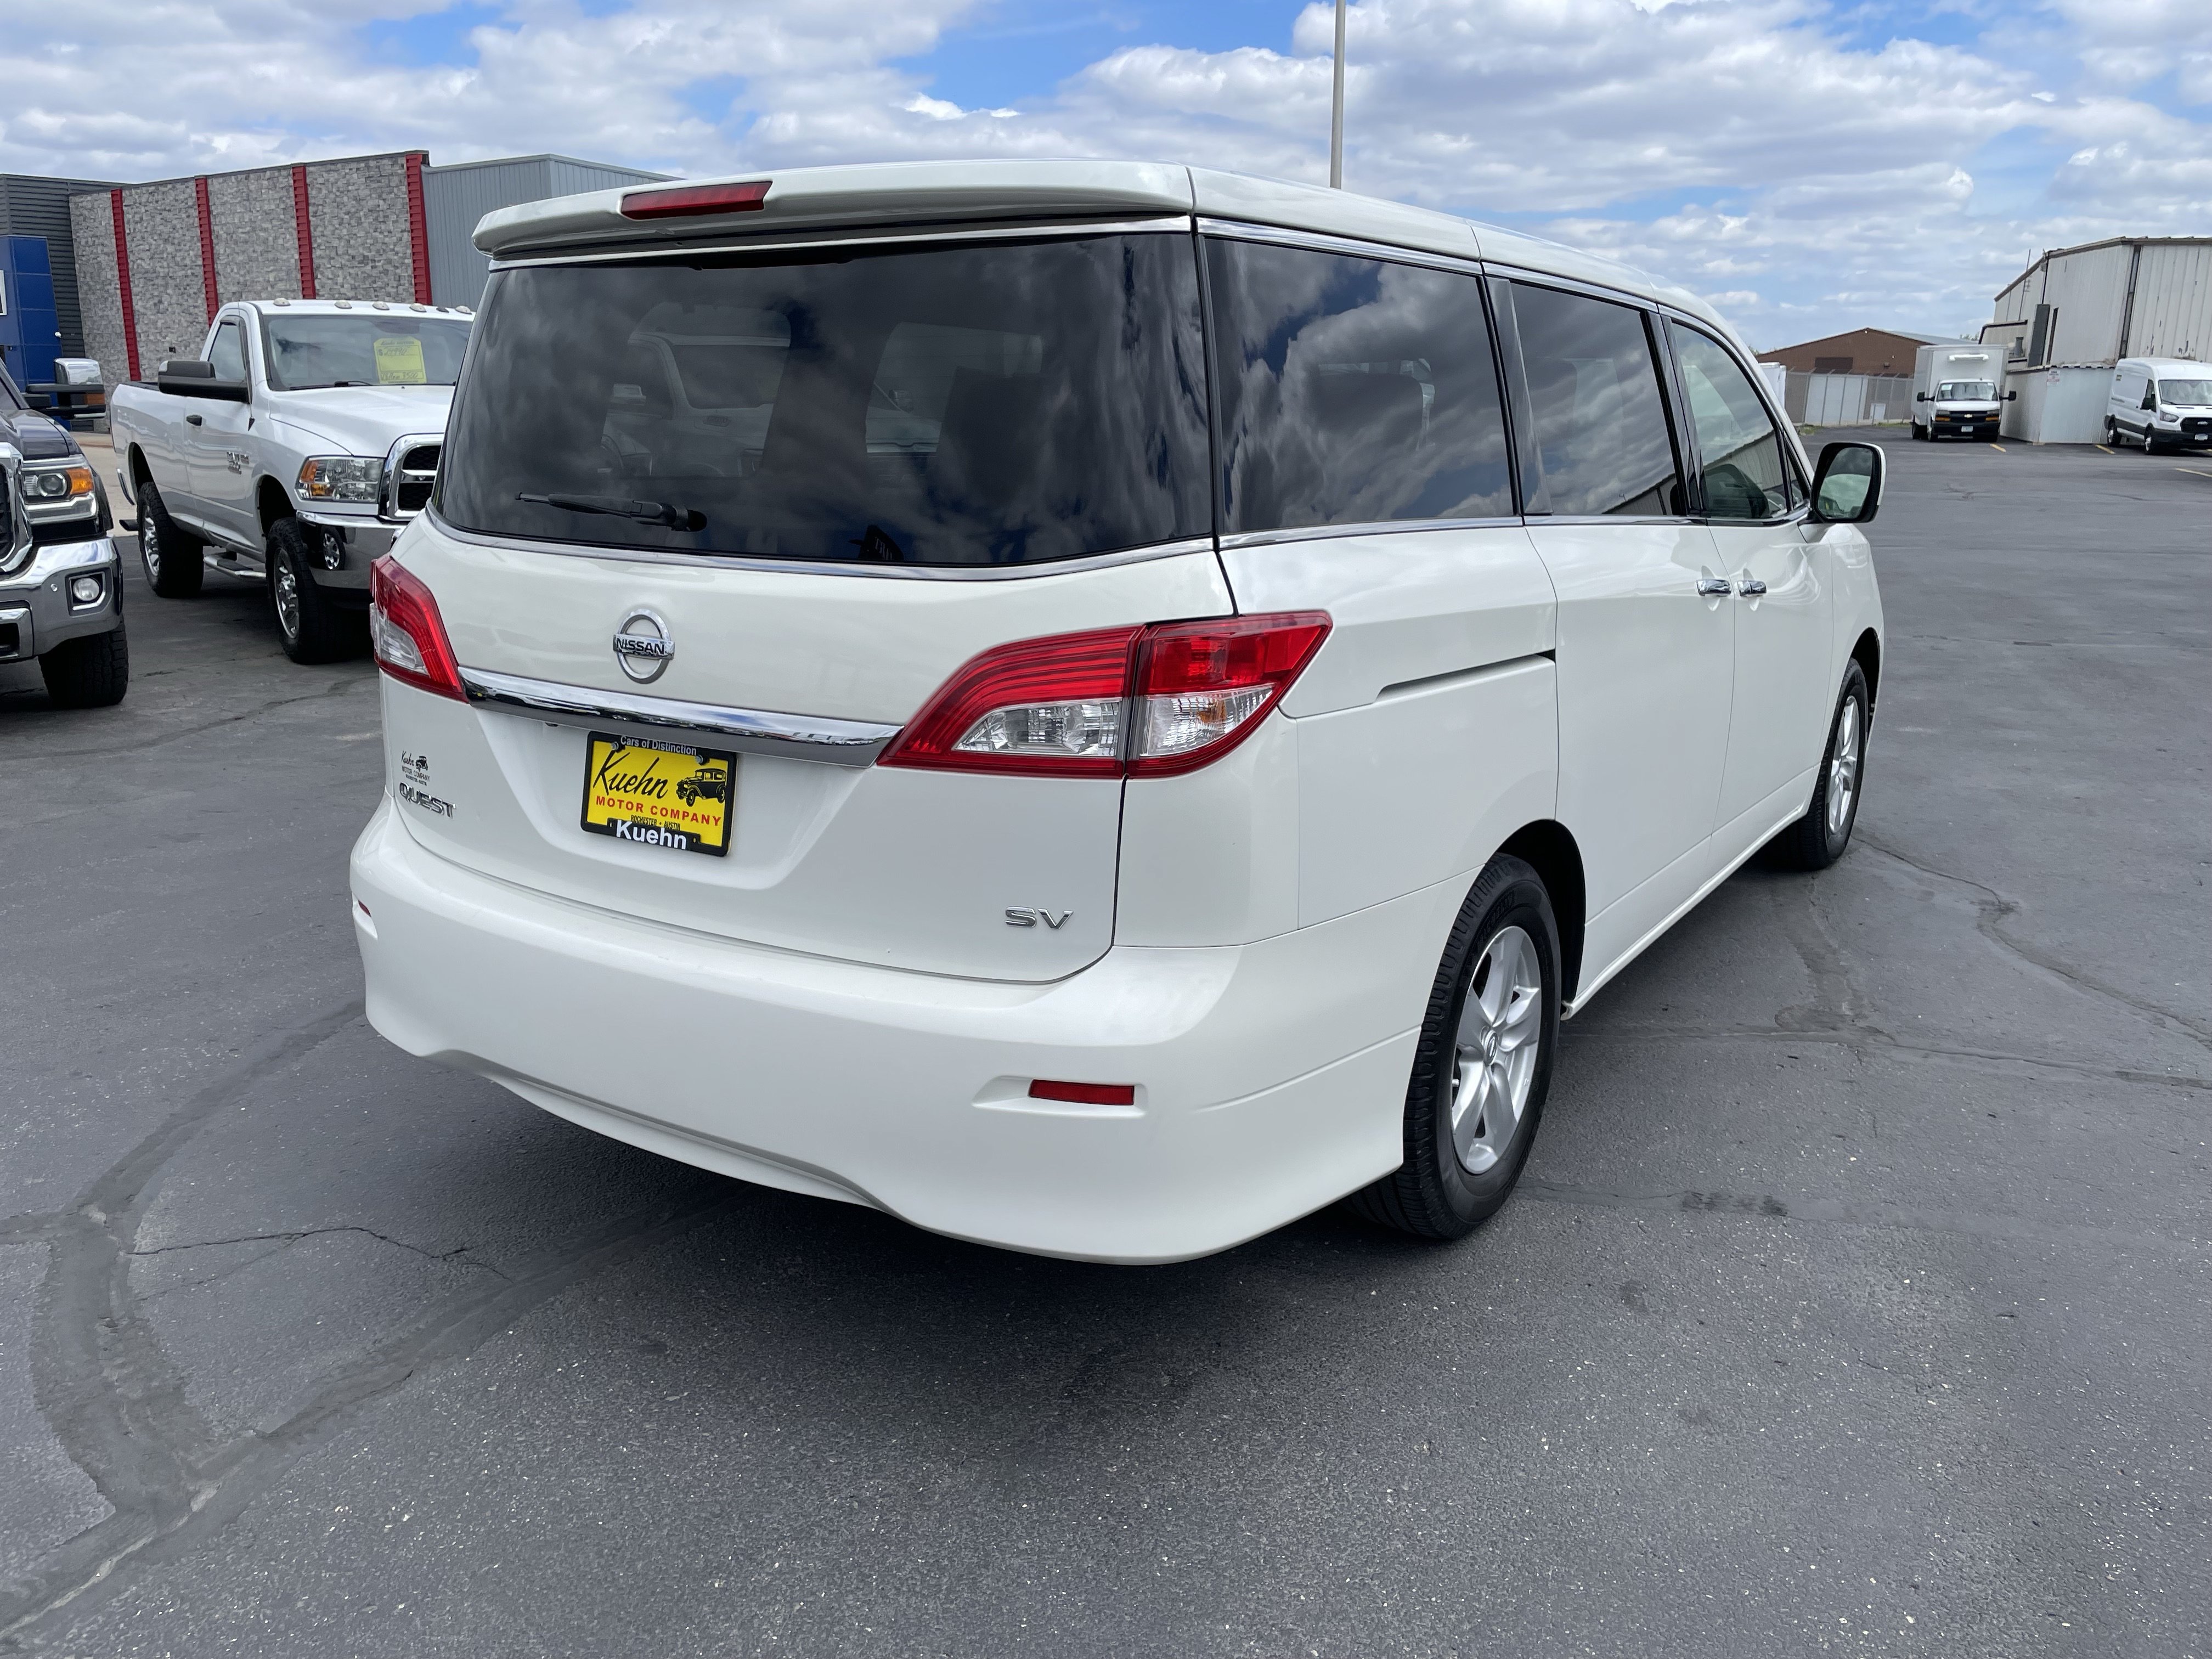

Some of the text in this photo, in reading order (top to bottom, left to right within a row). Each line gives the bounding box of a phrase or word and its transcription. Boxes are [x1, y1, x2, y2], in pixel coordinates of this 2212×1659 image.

[617, 637, 664, 654] NISSAN
[620, 736, 697, 755] Cars of Distinction
[414, 770, 430, 781] COMPANY
[592, 750, 668, 799] Kuehn
[399, 782, 456, 819] QUEST
[596, 796, 721, 827] MOTOR COMPANY
[630, 815, 680, 831] ROCHESTER AUSTIN
[616, 820, 686, 850] Kuehn
[1005, 906, 1074, 929] SV
